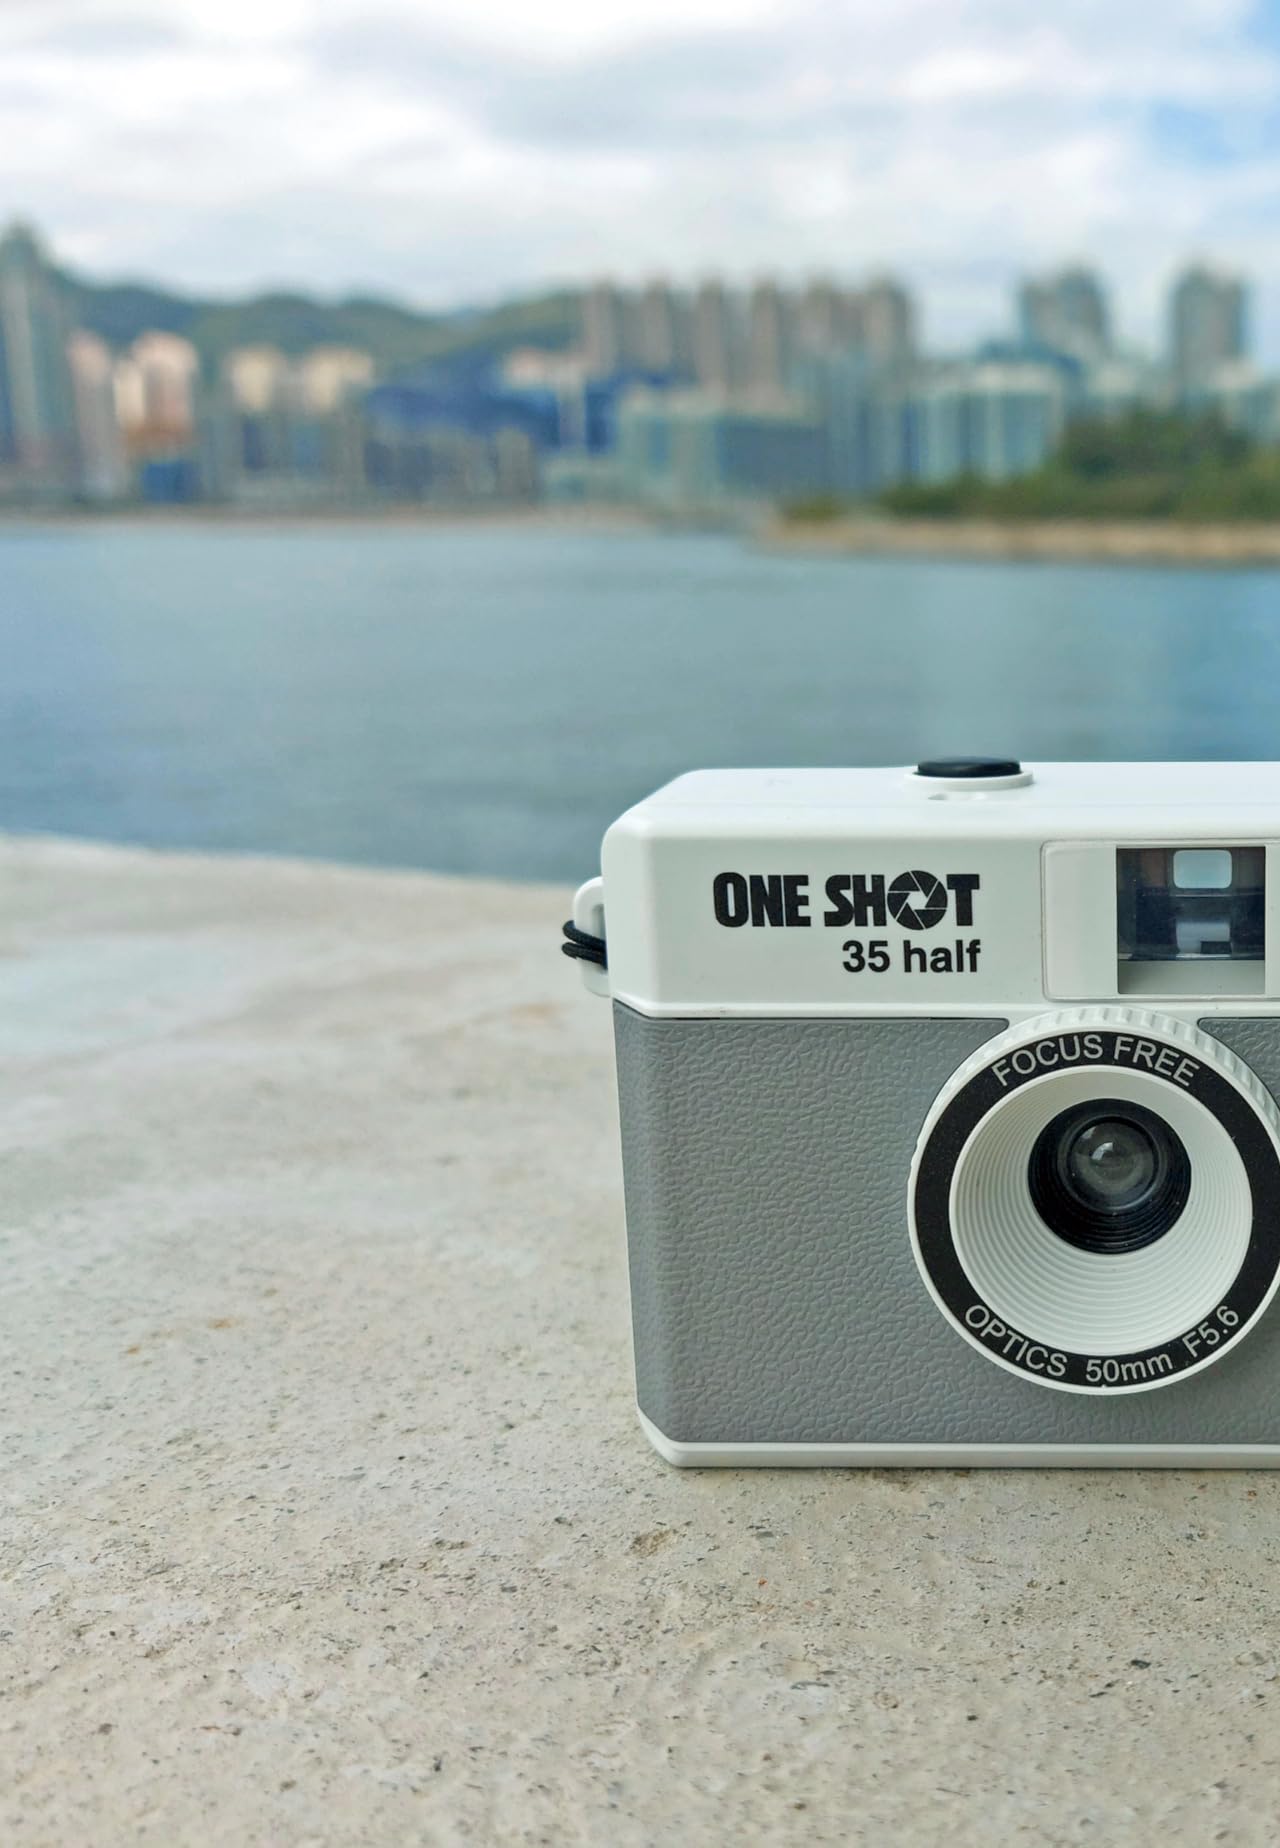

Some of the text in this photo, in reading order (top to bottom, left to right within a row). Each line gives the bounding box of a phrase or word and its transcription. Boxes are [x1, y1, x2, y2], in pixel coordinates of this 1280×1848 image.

[713, 870, 980, 930] ONE SHOT
[842, 939, 981, 973] 35 half
[991, 1034, 1200, 1087] FOCUS FREE
[965, 1304, 1240, 1383] OPTICS 50mm F5.6
